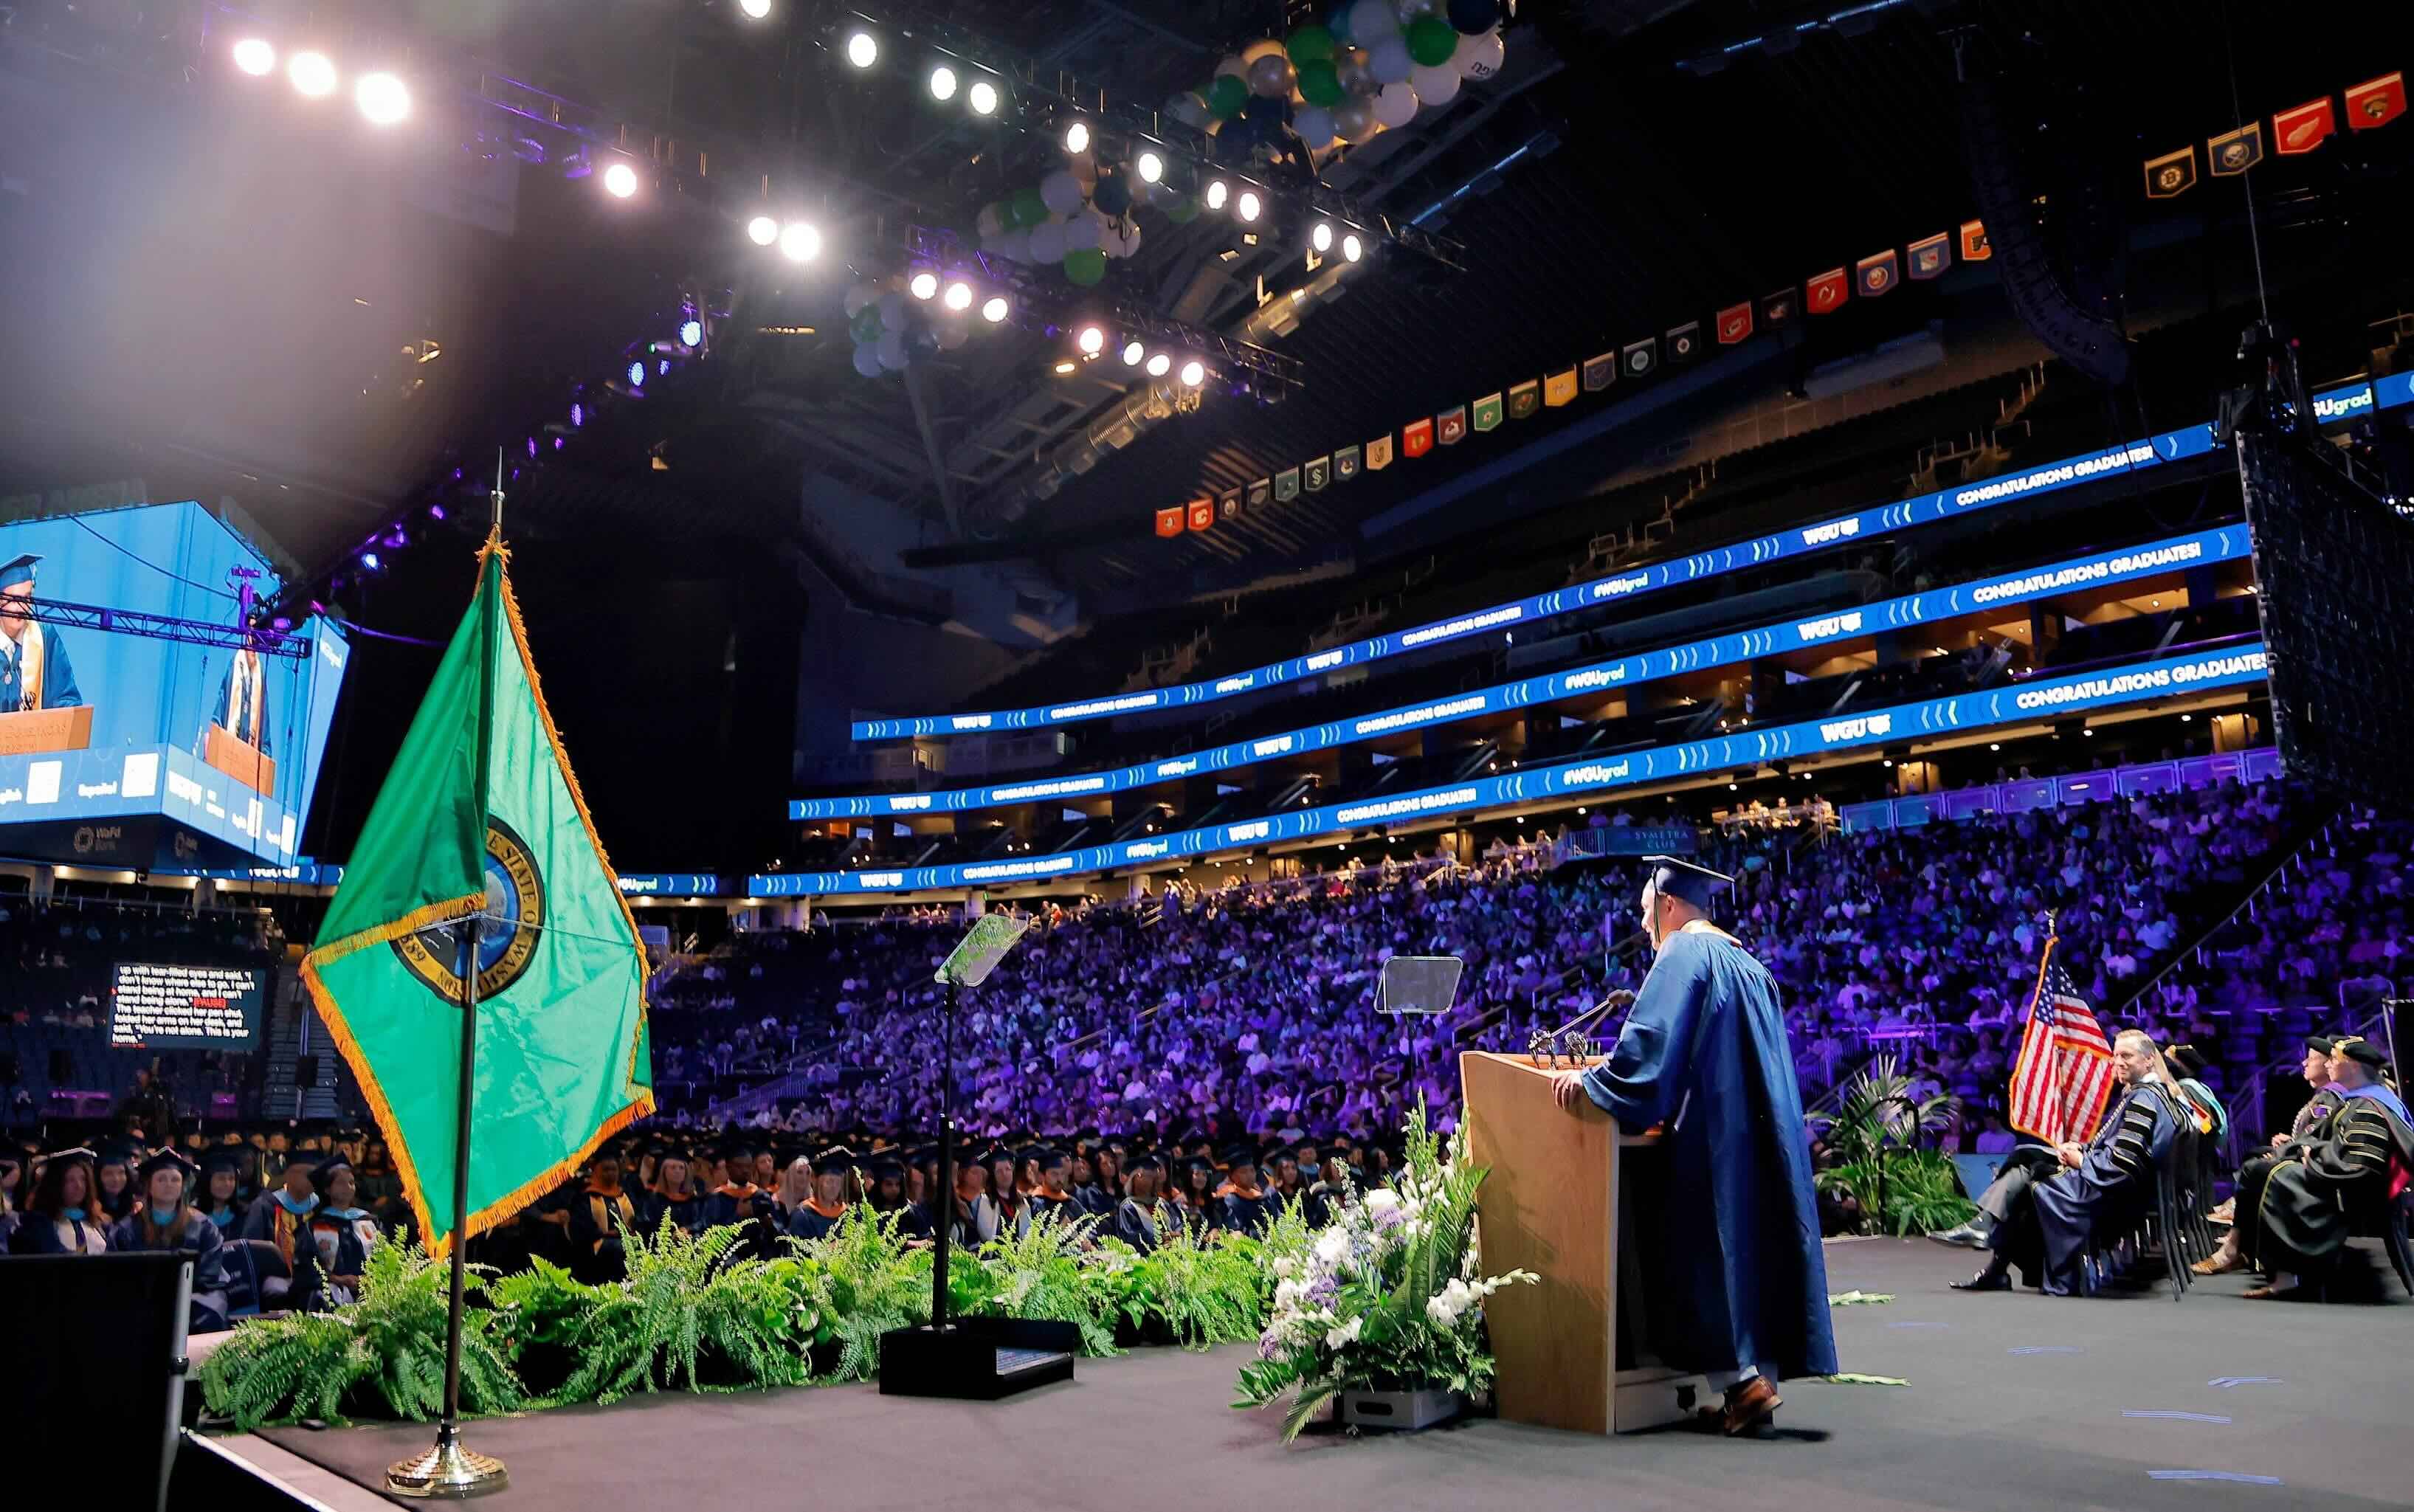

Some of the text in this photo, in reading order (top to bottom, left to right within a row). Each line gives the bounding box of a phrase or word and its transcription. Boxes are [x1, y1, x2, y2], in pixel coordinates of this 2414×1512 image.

[2313, 388, 2372, 416] Ugrad
[1956, 446, 2153, 505] CONGRATULATIONS GRADUATES!
[1593, 572, 1648, 597] #WGUgrad
[1973, 542, 2201, 603] CONGRATULATIONS GRADUATES!
[1402, 618, 1474, 646] CONGRATULATIONS
[1565, 664, 1624, 688] #WGUgrad
[2017, 667, 2170, 708] CONGRATULATIONS
[1356, 708, 1434, 733] CONGRATULATIONS
[1821, 714, 1867, 742] WGU
[1564, 760, 1628, 784] #WGUgrad
[1337, 788, 1476, 823] CONGRATULATIONS GRADUATES!
